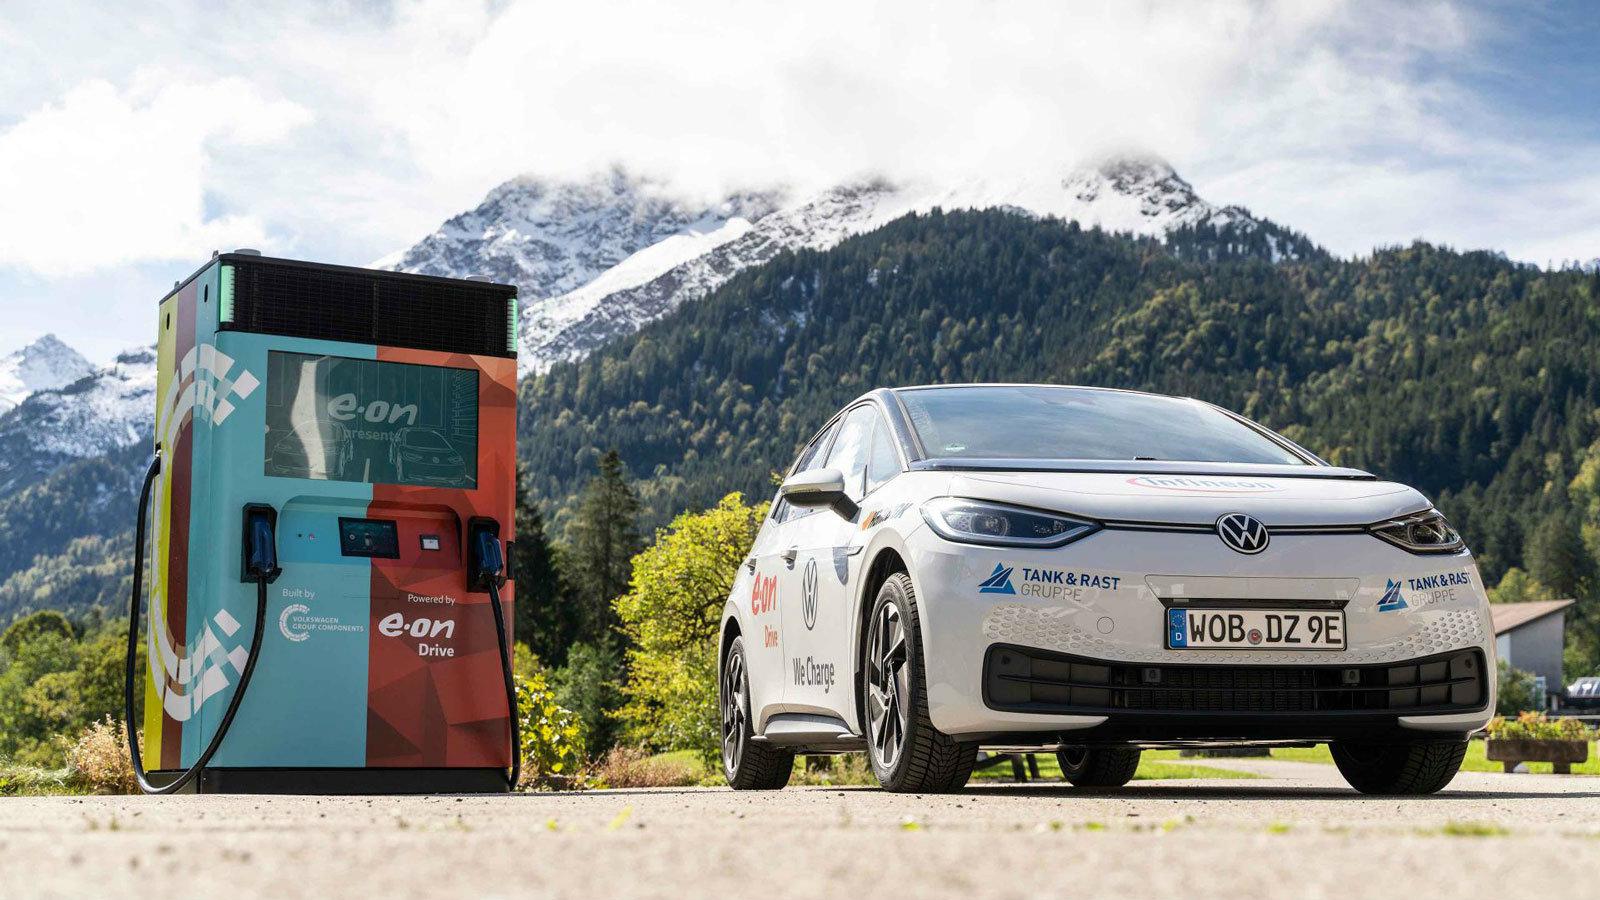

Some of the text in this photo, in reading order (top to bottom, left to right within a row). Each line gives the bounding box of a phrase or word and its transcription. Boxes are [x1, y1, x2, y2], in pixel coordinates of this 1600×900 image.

[282, 588, 315, 599] Built by
[407, 594, 456, 606] Powered by
[1020, 583, 1082, 602] GRUPPE
[1410, 589, 1457, 607] GRUPPE
[292, 623, 364, 633] GROUP COMPONENTS
[293, 616, 339, 624] VOLKSWAGEN
[764, 624, 779, 648] Drive
[1189, 614, 1342, 645] WOB DZ 9E
[418, 643, 455, 657] Drive
[793, 656, 835, 694] We Charge
